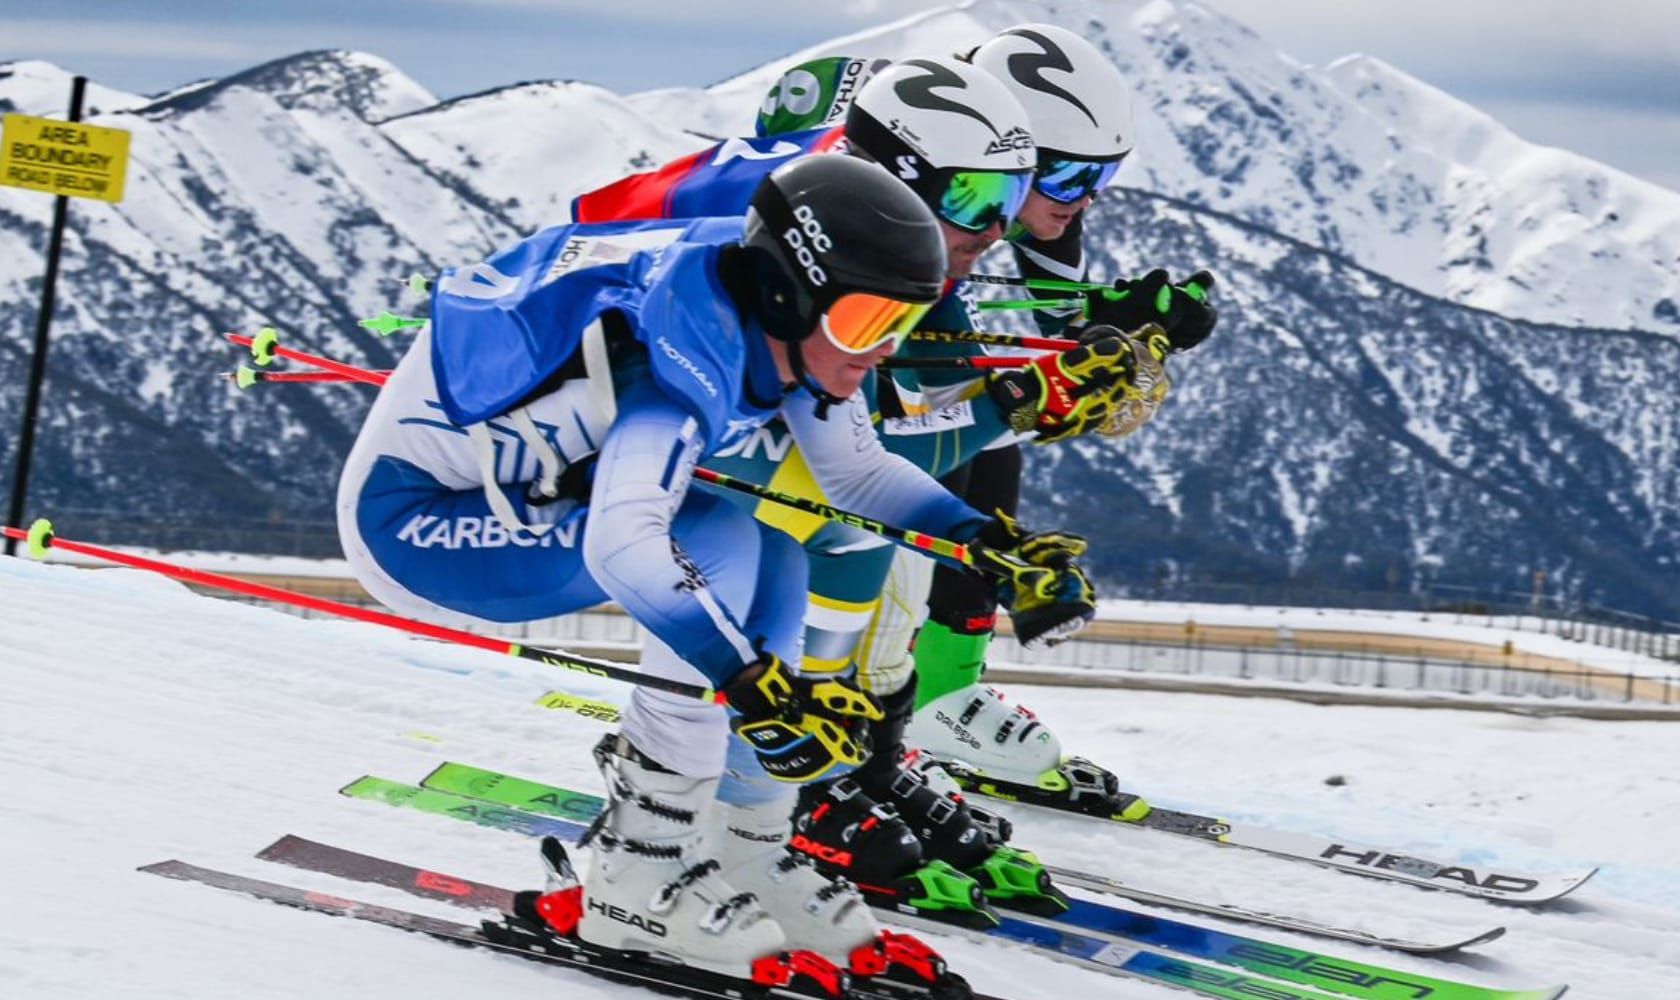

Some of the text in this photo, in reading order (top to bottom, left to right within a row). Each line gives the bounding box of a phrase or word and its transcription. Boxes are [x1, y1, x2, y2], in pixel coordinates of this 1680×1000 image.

[822, 60, 863, 125] OTHA
[40, 126, 90, 147] AREA
[11, 142, 113, 170] BOUNDARY
[7, 166, 109, 193] ROAD BELOW
[588, 897, 667, 938] HEAD
[1226, 944, 1434, 999] elan
